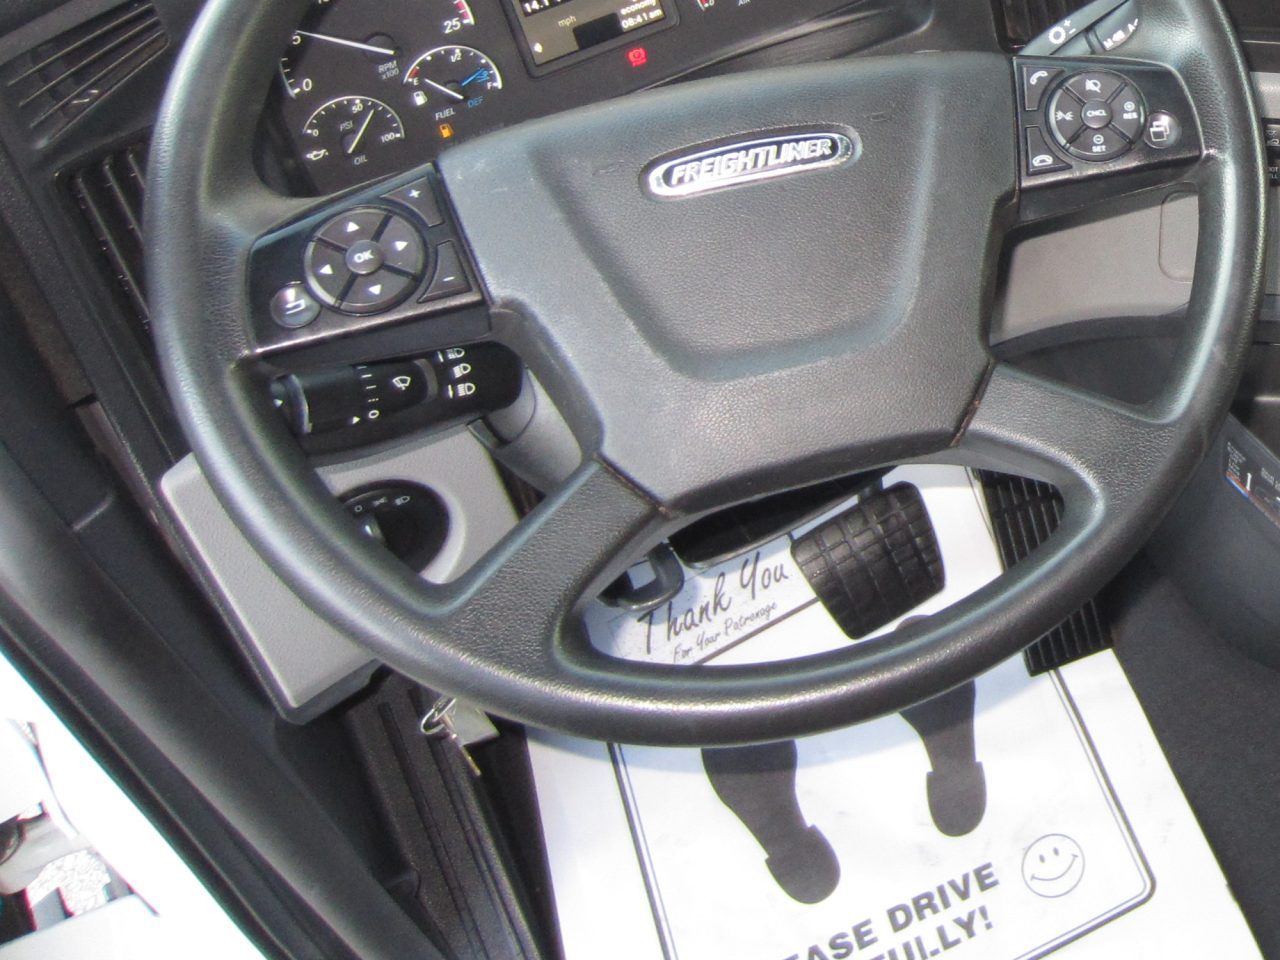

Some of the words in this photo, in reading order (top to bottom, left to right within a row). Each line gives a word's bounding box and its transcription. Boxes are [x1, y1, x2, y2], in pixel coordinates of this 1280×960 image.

[558, 14, 577, 28] mph
[621, 12, 648, 29] 08:41
[649, 8, 663, 19] am
[444, 18, 461, 33] 25
[378, 60, 398, 73] RPM
[382, 68, 399, 80] x100
[303, 78, 312, 90] 0
[413, 78, 419, 86] E
[467, 96, 484, 108] DEF
[352, 104, 363, 114] 50
[435, 108, 456, 120] FUEL
[340, 121, 353, 131] PSI
[312, 129, 319, 137] 0
[381, 132, 395, 143] 100
[354, 155, 368, 165] OIL
[670, 139, 832, 185] FREIGHTLINER
[353, 250, 373, 262] OK
[637, 571, 734, 655] Thank
[739, 551, 789, 599] You
[673, 643, 692, 663] For
[696, 631, 722, 651] Your
[724, 601, 778, 637] Patronage
[886, 862, 1000, 934] DRIVE
